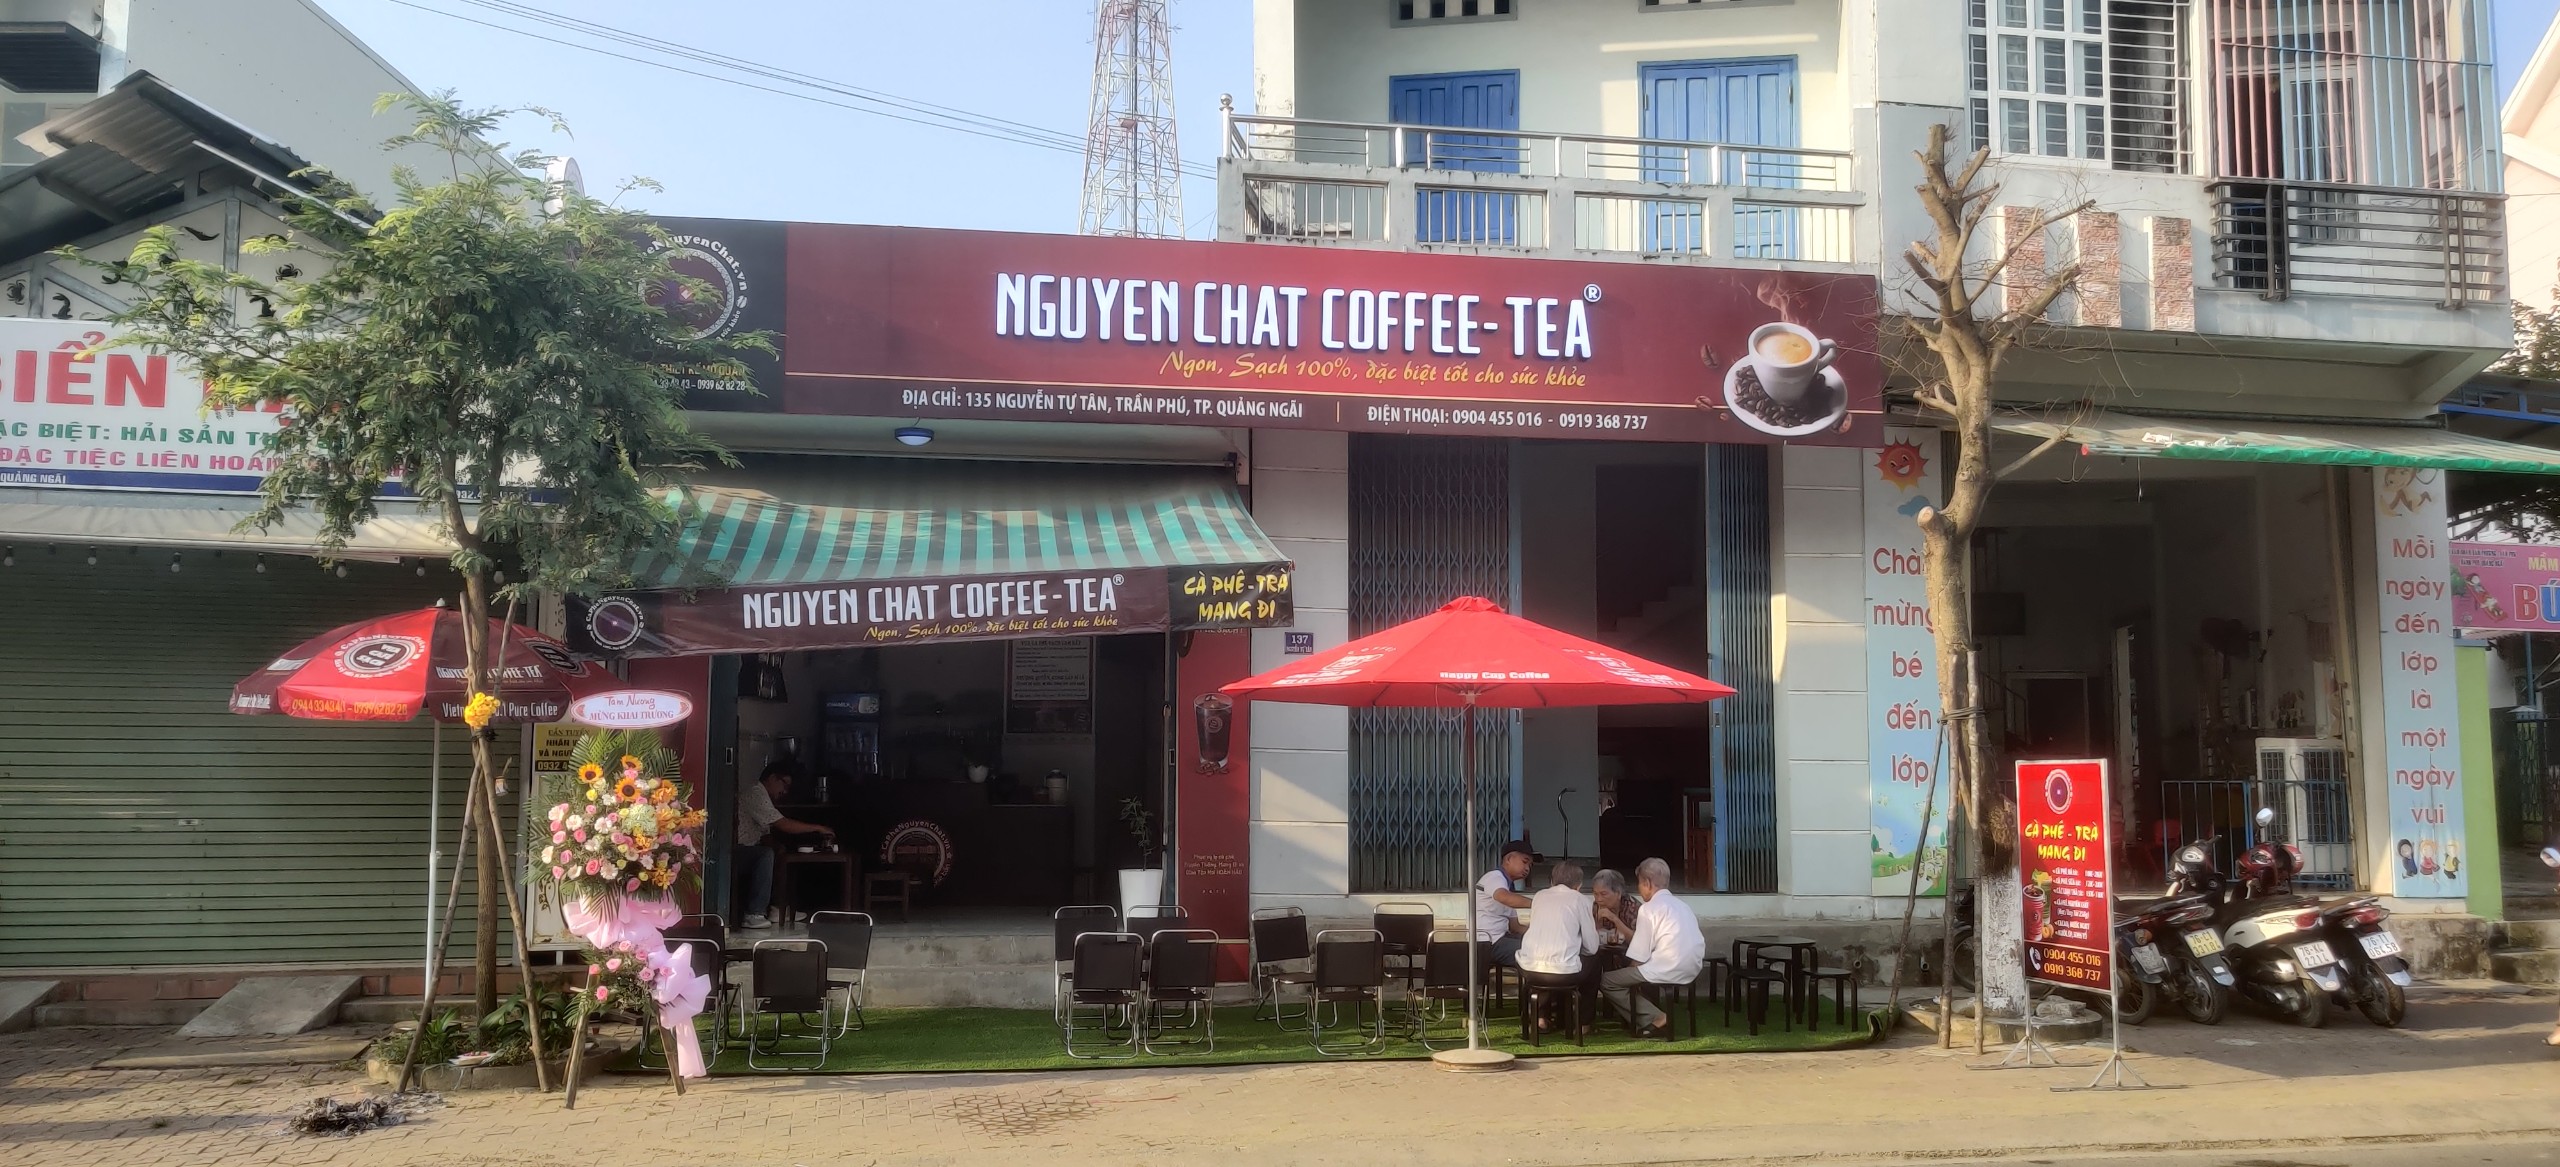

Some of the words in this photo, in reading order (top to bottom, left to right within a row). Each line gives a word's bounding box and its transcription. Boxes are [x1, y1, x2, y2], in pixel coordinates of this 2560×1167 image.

[995, 272, 1180, 342] NGUYEN
[1193, 281, 1308, 348] CHAT
[1320, 287, 1593, 360] COFFEE-TEA
[0, 331, 168, 408] IỂN
[1159, 350, 1224, 379] Ngon,
[1228, 352, 1289, 380] Sạch
[1295, 356, 1358, 381] 100%,
[1364, 359, 1398, 385] đặc
[1403, 360, 1437, 386] biệt
[1443, 360, 1470, 383] tốt
[1474, 363, 1505, 385] cho
[1510, 365, 1539, 386] sức
[1544, 364, 1587, 387] khỏe
[697, 379, 714, 390] 0939
[715, 380, 725, 391] 62
[726, 381, 736, 391] 82
[736, 380, 746, 391] 28
[902, 388, 929, 411] ĐỊA
[931, 388, 962, 408] CHỈ:
[965, 391, 992, 408] 135
[995, 388, 1054, 411] NGUYỄN
[1057, 393, 1077, 415] TỰ
[1079, 393, 1112, 415] TÂN,
[1115, 392, 1153, 414] TRẦN
[1156, 395, 1191, 417] PHÚ,
[1194, 398, 1213, 416] TP.
[1216, 395, 1266, 418] QUẢNG
[1269, 398, 1303, 418] NGÃI
[1367, 404, 1400, 426] ĐIỆN
[1403, 405, 1449, 428] THOẠI:
[1452, 409, 1487, 426] 0904
[1488, 410, 1514, 427] 455
[1517, 411, 1543, 427] 016
[1559, 412, 1593, 428] 0919
[1595, 413, 1621, 430] 368
[1623, 414, 1648, 430] 737
[120, 422, 167, 443] HẢI
[178, 424, 235, 446] SẢN
[64, 448, 126, 467] TIỆC
[136, 450, 199, 469] LIÊN
[1872, 547, 1925, 575] Chà
[1183, 570, 1207, 597] CÀ
[2385, 575, 2445, 600] ngày
[742, 588, 859, 629] NGUYEN
[867, 584, 940, 623] CHAT
[949, 576, 1118, 620] COFFEE-TEA
[1198, 600, 1252, 622] MANG
[1257, 599, 1276, 619] ĐI
[863, 625, 902, 641] Ngon,
[904, 622, 942, 639] Sạch
[985, 619, 1003, 635] đặc
[1008, 618, 1030, 634] biệt
[1032, 616, 1048, 631] tốt
[1051, 616, 1070, 630] cho
[1072, 615, 1089, 629] sức
[1092, 614, 1118, 627] khỏe
[2395, 611, 2440, 633] đến
[1291, 634, 1309, 644] 137
[1891, 650, 1923, 678] bé
[2401, 650, 2438, 676] lớp
[1508, 671, 1550, 680] Coffee
[508, 702, 528, 717] Pure
[530, 702, 558, 717] Coffee
[2411, 688, 2432, 709] là
[617, 711, 638, 720] KHAI
[1886, 699, 1932, 730] đến
[2401, 727, 2447, 751] một
[537, 761, 561, 771] 0932
[1891, 753, 1929, 788] lớp
[2396, 764, 2455, 790] ngày
[2411, 804, 2445, 824] vui
[2024, 819, 2039, 838] CÀ
[2075, 821, 2099, 842] TRÀ
[2037, 844, 2071, 861] MANG
[2043, 947, 2066, 961] 0904
[2067, 951, 2084, 964] 455
[2085, 954, 2101, 967] 016
[2043, 962, 2064, 976] 0919
[2065, 965, 2083, 979] 368
[2084, 968, 2101, 982] 737
